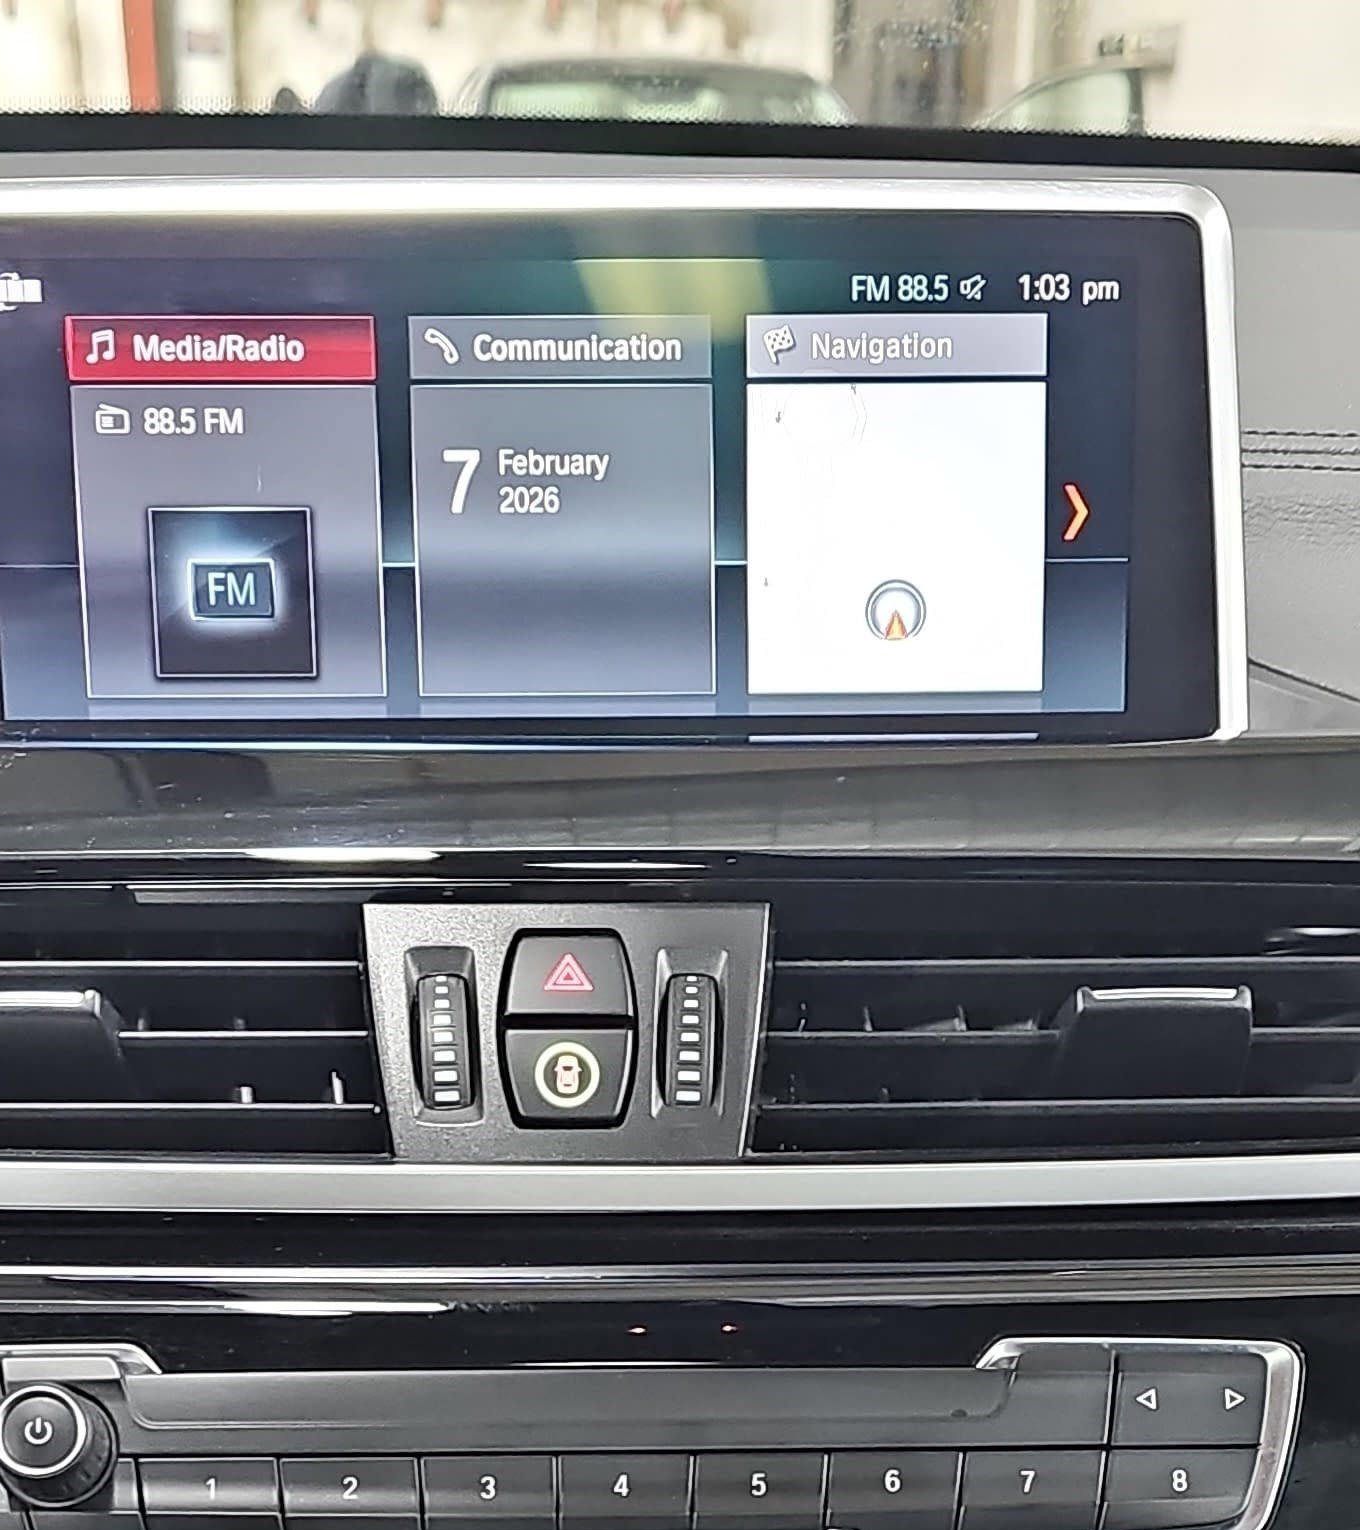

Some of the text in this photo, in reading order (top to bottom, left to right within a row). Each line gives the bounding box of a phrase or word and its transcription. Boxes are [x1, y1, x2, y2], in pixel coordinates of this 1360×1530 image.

[851, 275, 949, 302] FM 88.5
[1017, 273, 1120, 306] 1:03 pm
[133, 334, 304, 362] Media/Radio
[473, 333, 682, 362] Communication
[811, 331, 953, 365] Navigation
[143, 407, 244, 434] 88.5 FM
[498, 448, 609, 480] February
[442, 449, 481, 514] 7
[499, 486, 560, 514] 2026
[207, 571, 256, 606] FM
[204, 1477, 217, 1500] 1
[341, 1476, 359, 1500] 2
[479, 1475, 497, 1500] 3
[613, 1474, 630, 1497] 4
[750, 1472, 768, 1496] 5
[884, 1469, 901, 1493] 6
[1020, 1470, 1036, 1493] 7
[1171, 1469, 1189, 1493] 8
